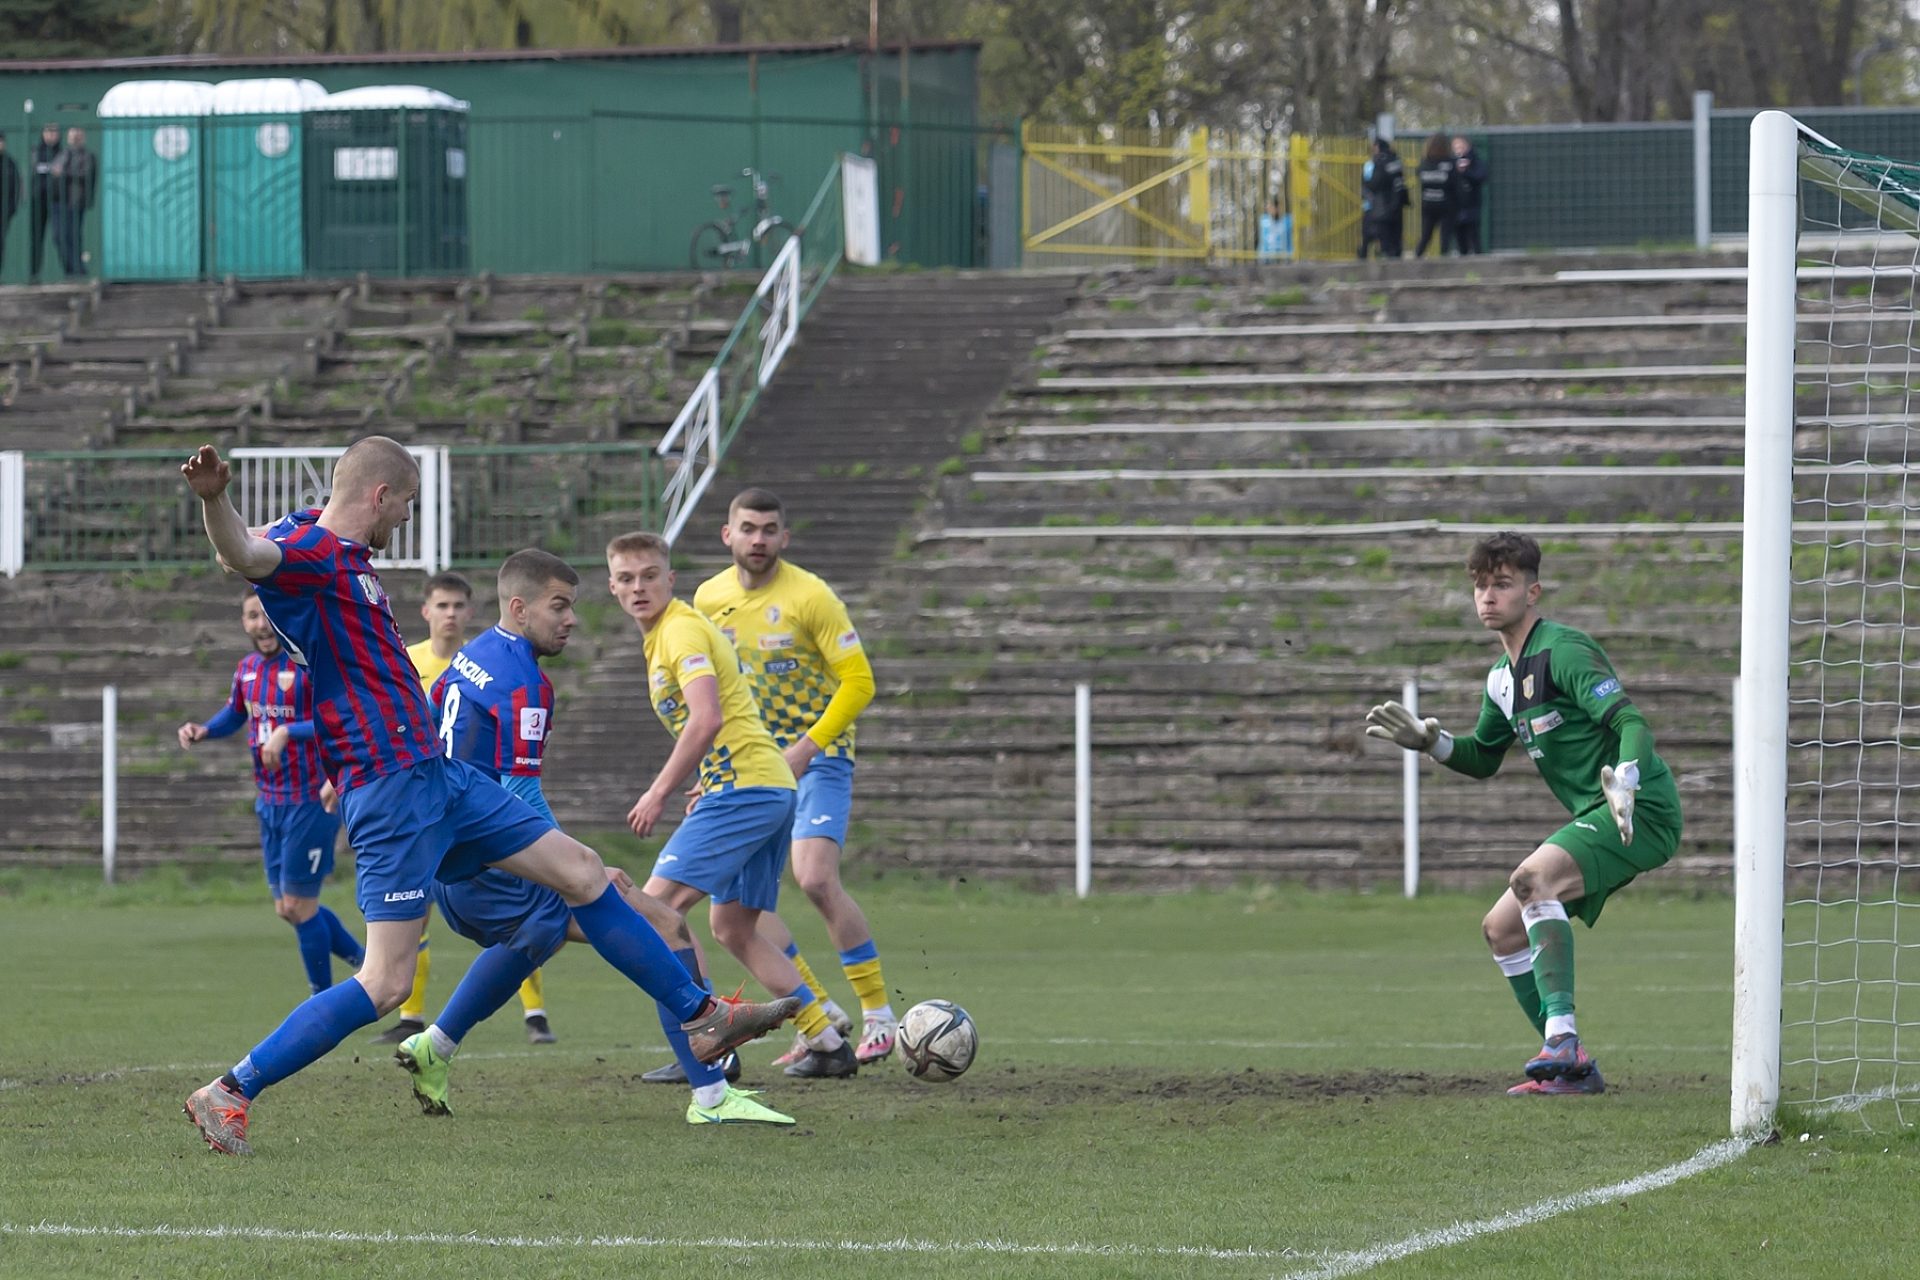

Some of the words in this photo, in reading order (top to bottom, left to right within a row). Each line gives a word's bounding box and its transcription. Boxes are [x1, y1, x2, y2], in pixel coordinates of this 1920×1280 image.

[439, 683, 461, 759] 8
[308, 848, 322, 875] 7
[384, 889, 424, 903] LEGEA
